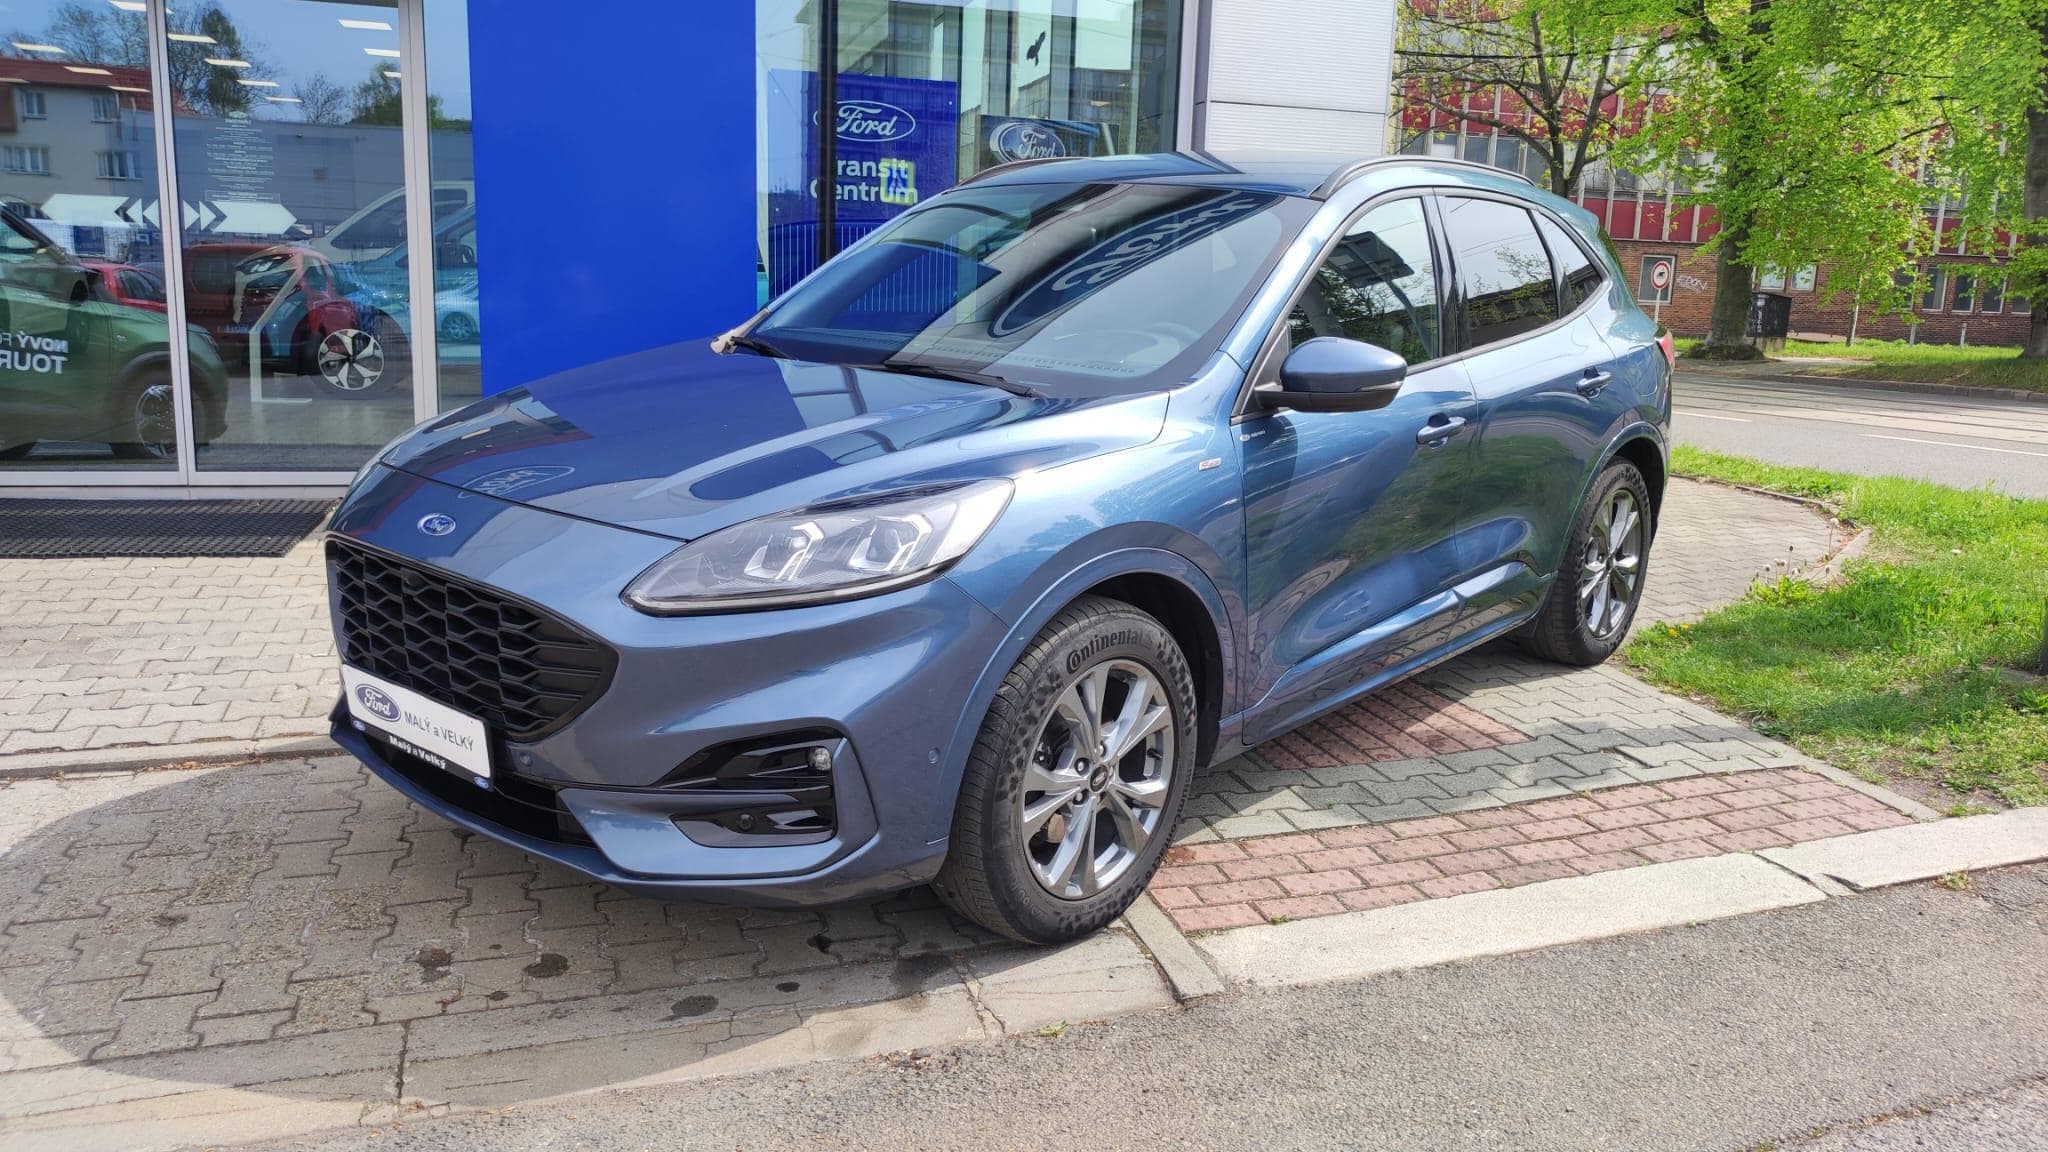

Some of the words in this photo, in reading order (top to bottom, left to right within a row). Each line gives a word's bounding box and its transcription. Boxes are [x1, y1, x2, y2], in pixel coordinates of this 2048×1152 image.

[837, 105, 898, 136] Ford
[1018, 129, 1057, 159] Ford
[837, 158, 908, 178] ransit
[1066, 628, 1143, 674] Continental
[364, 688, 392, 716] Ford
[404, 710, 430, 733] MALÝ
[433, 726, 440, 737] a
[440, 726, 473, 751] VELKÝ
[388, 735, 412, 754] Malý
[418, 748, 447, 770] Velký
